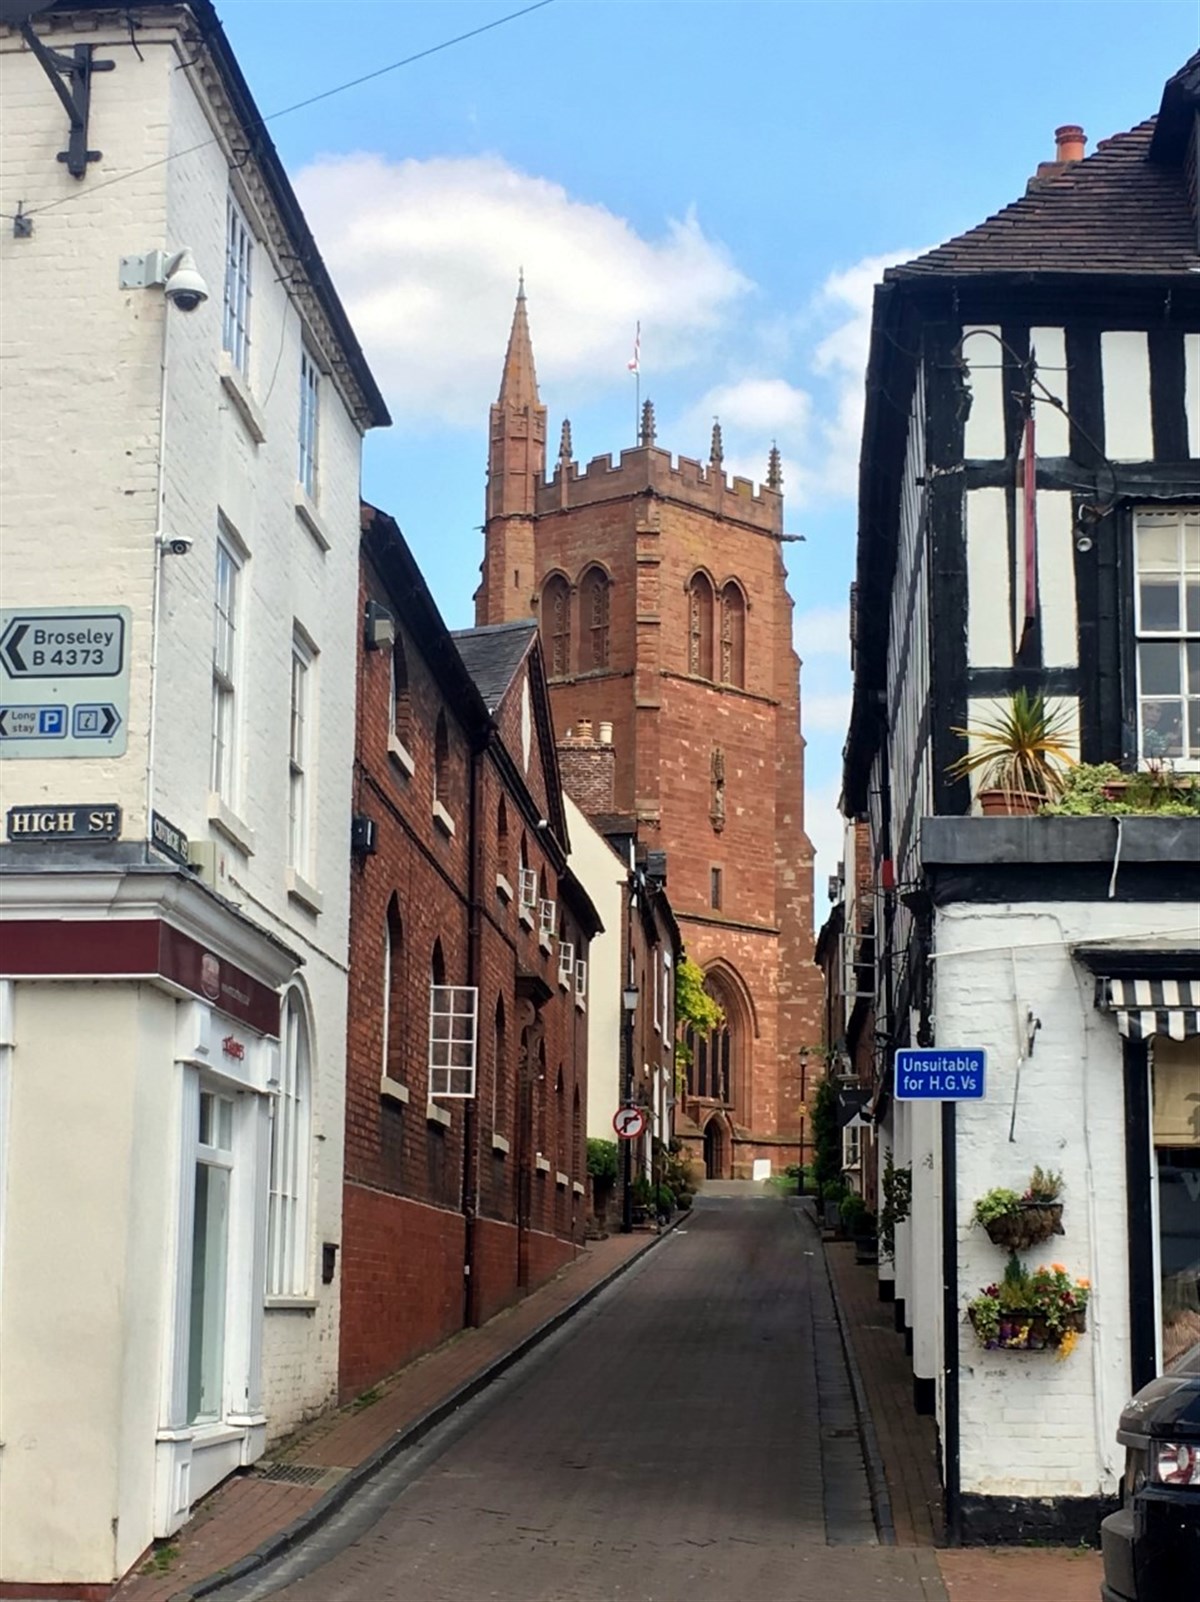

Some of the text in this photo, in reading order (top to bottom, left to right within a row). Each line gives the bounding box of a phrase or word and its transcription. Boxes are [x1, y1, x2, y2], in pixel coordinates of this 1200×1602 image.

[34, 628, 114, 647] Broseley
[11, 711, 36, 721] Long
[12, 723, 35, 734] stay
[12, 812, 76, 832] HIGH
[902, 1057, 979, 1072] Unsuitable
[903, 1076, 924, 1090] for
